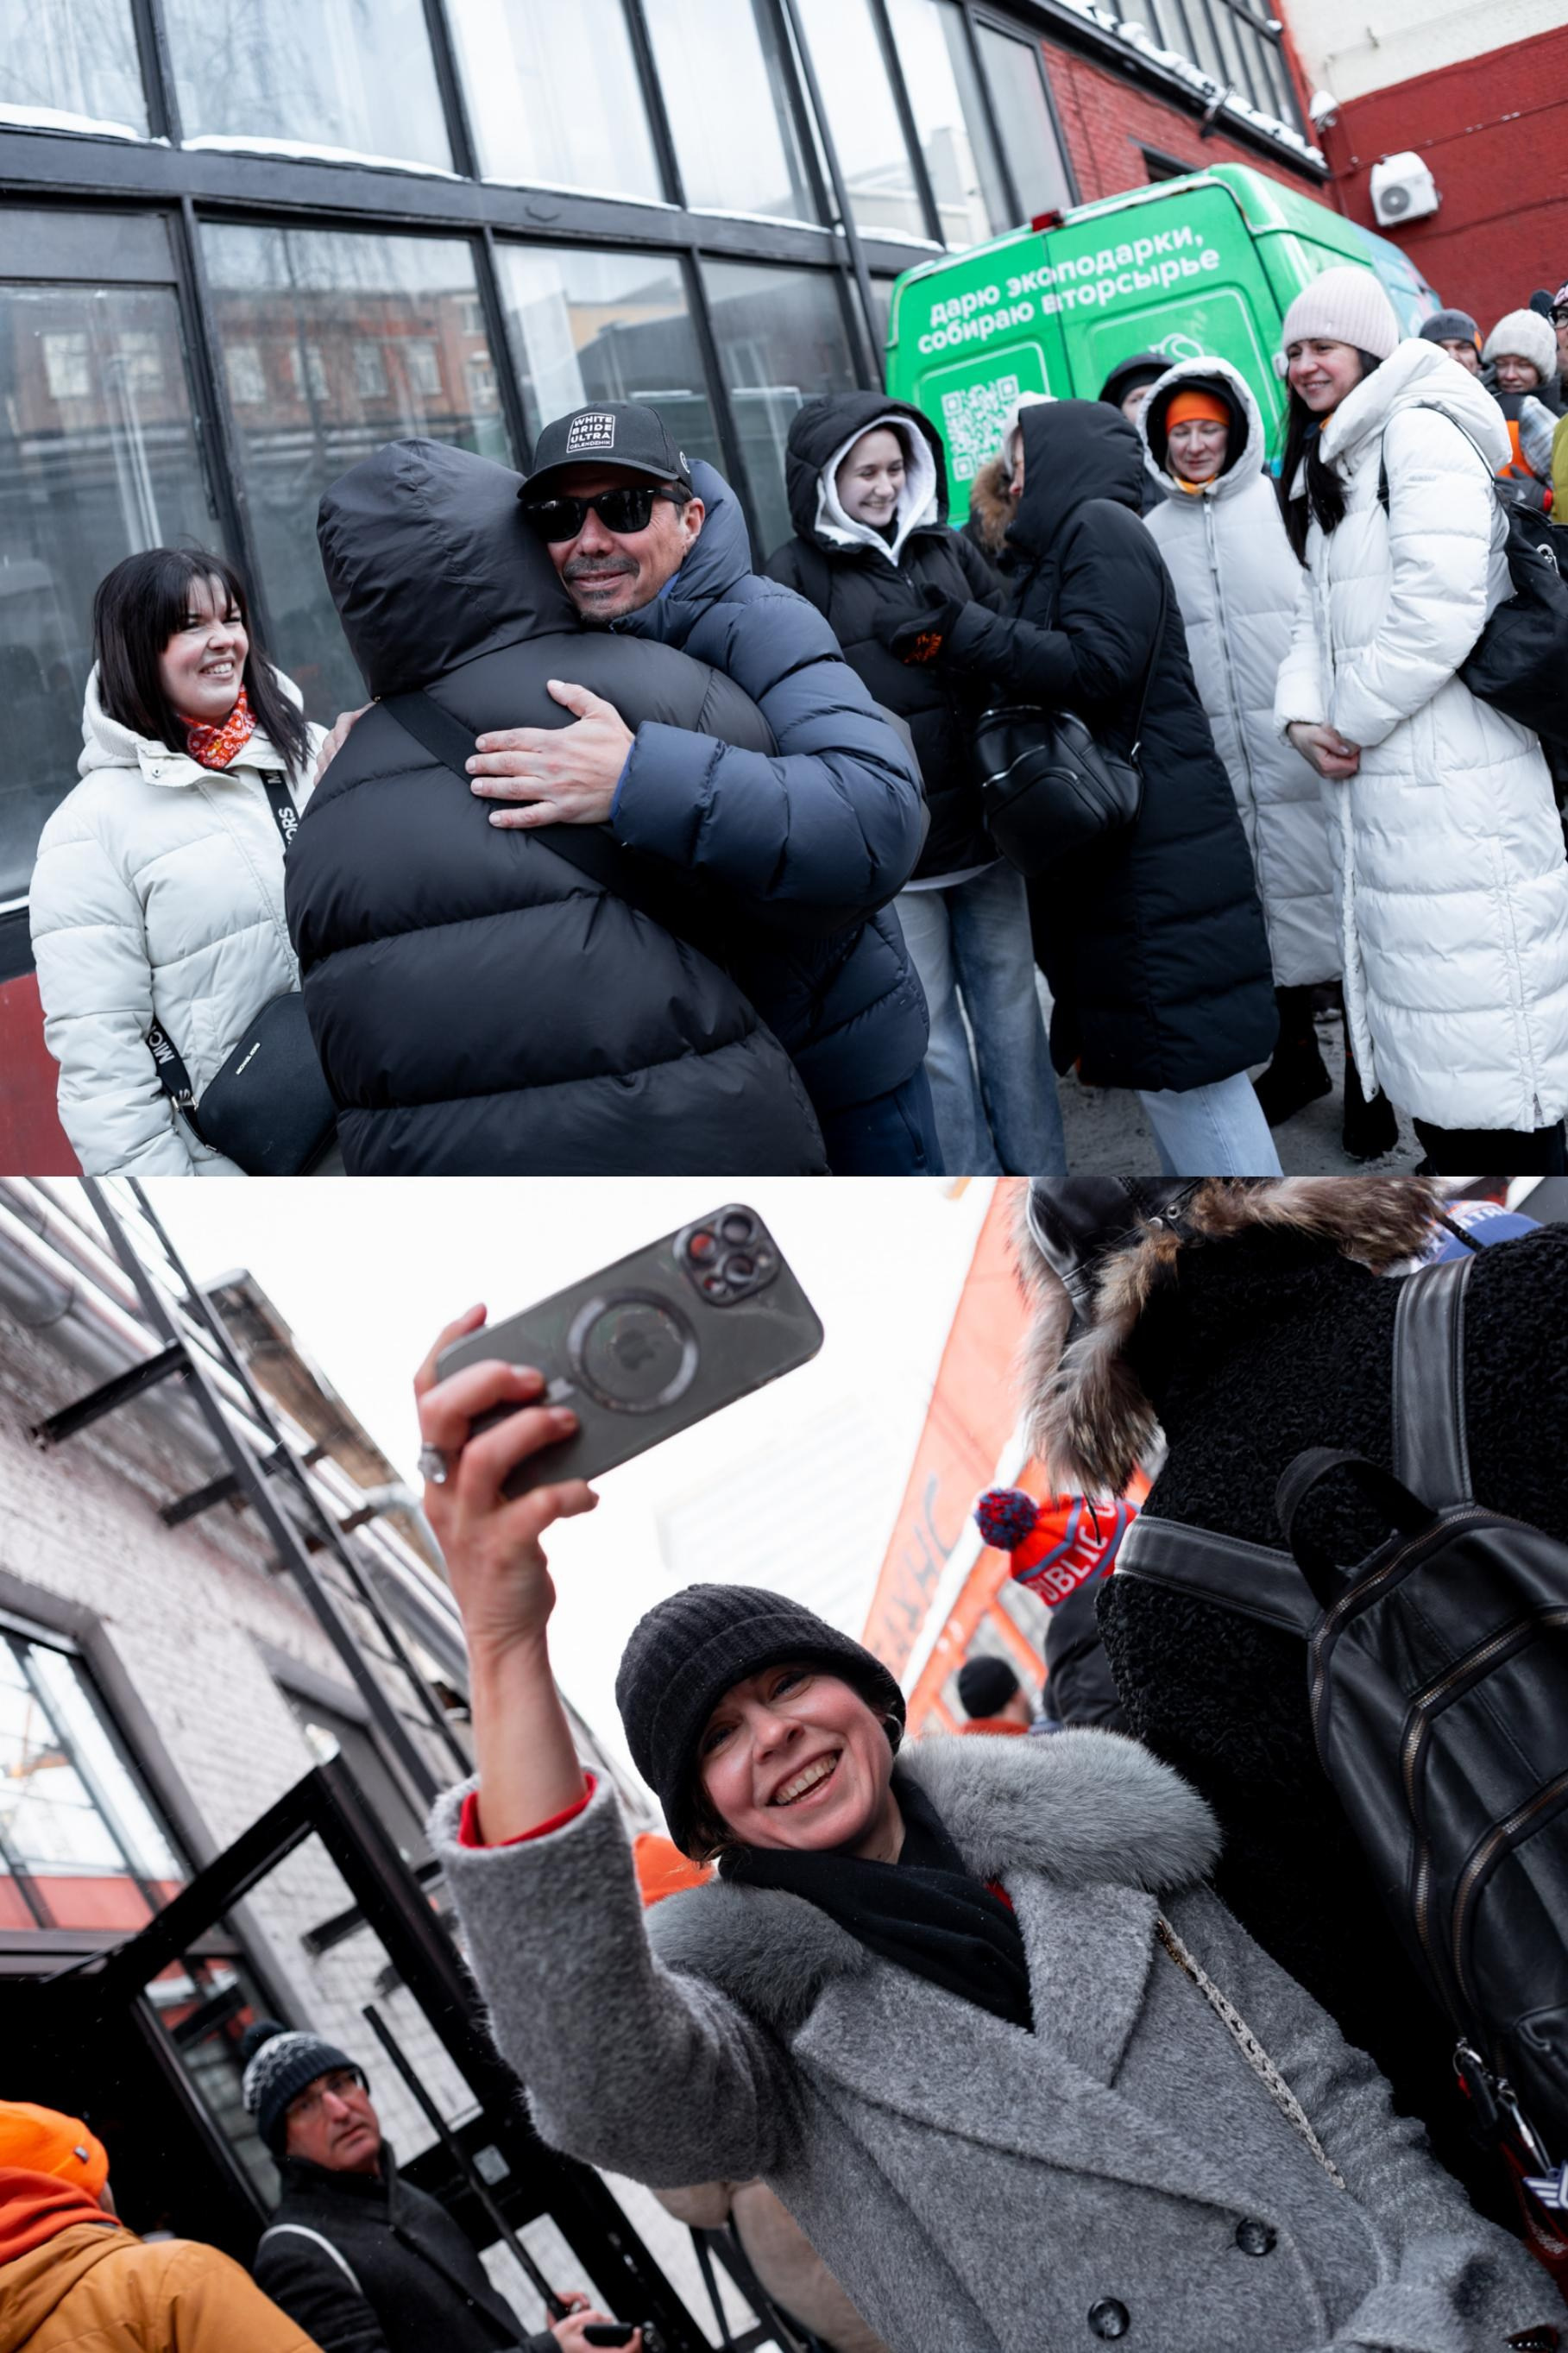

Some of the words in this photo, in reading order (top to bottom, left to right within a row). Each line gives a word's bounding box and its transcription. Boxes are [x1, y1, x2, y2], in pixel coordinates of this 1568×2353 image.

[930, 285, 1001, 329] дарю
[1005, 226, 1204, 298] экоподарки,
[917, 301, 1035, 354] собираю
[1041, 249, 1220, 315] вторсырье
[572, 424, 612, 435] BRIDE
[575, 415, 613, 426] WHITE
[570, 432, 611, 443] ULTRA
[278, 806, 299, 844] ORS
